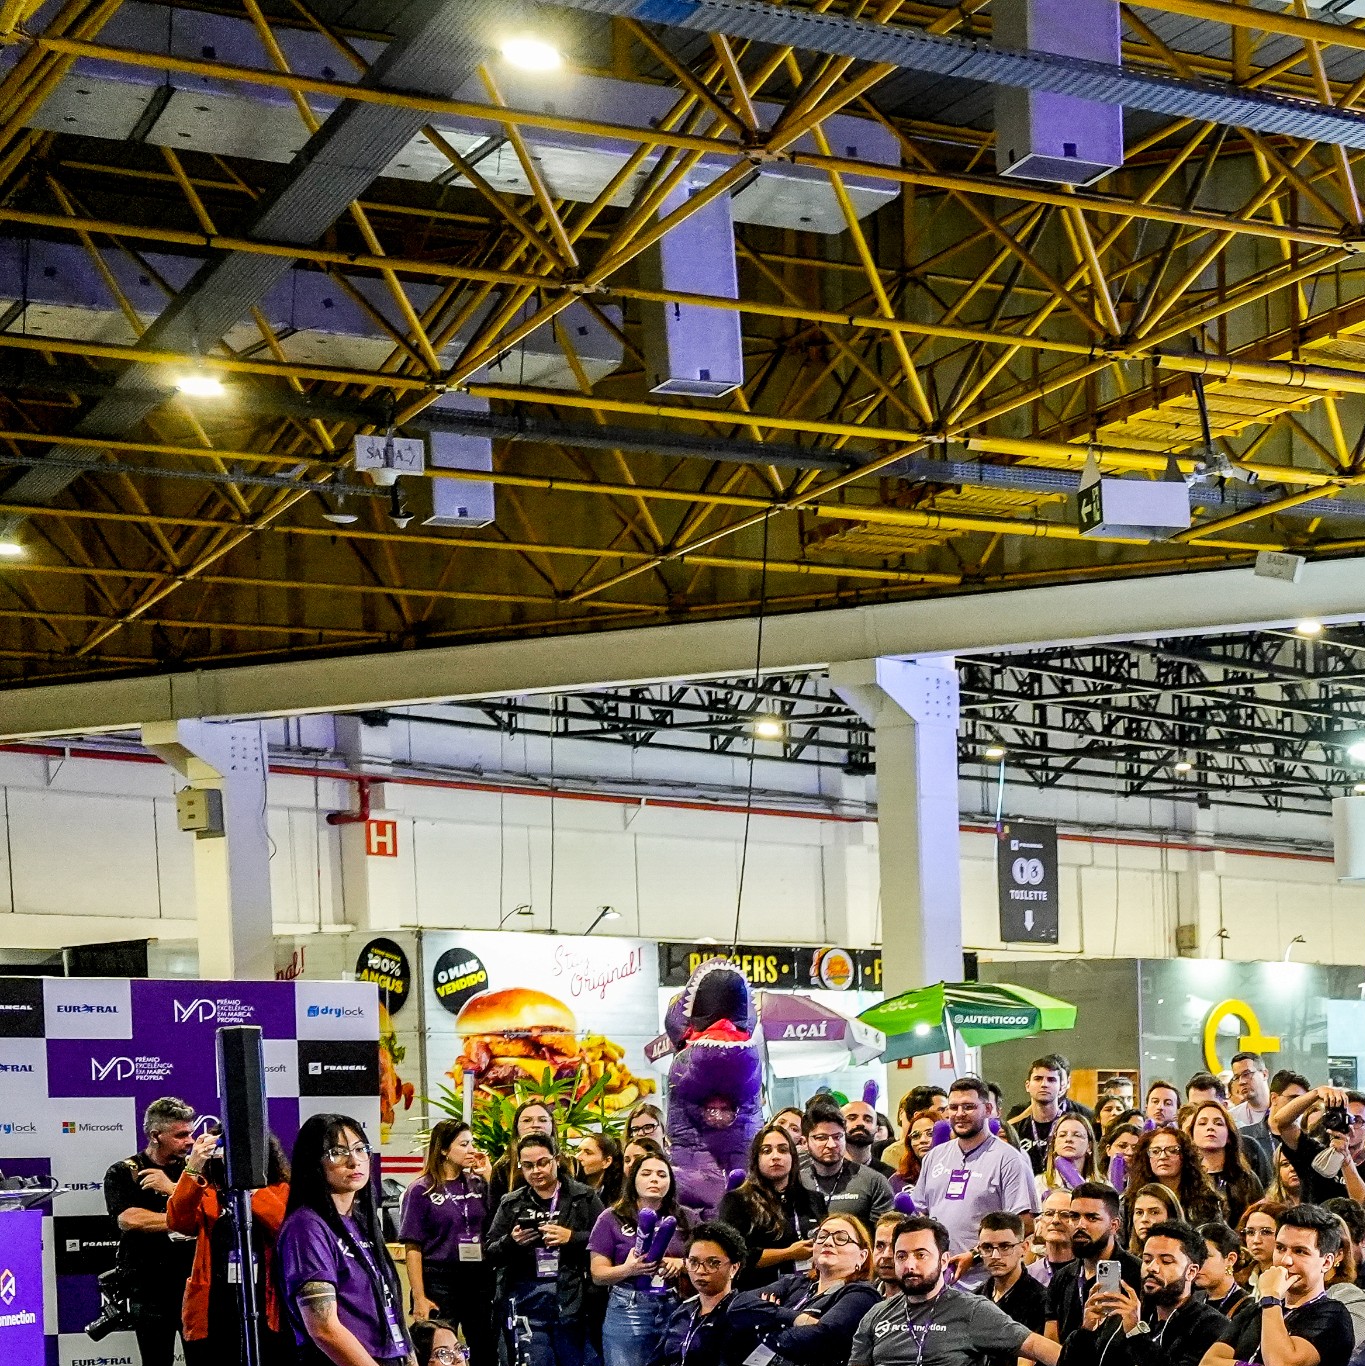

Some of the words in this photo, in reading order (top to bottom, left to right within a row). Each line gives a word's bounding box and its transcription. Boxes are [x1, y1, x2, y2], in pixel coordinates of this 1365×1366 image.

[366, 446, 403, 461] SAA
[370, 823, 394, 855] H
[1009, 890, 1048, 901] TOILETTE
[438, 972, 449, 984] O
[450, 959, 480, 980] MAIS
[359, 969, 404, 994] ANGUS
[436, 971, 487, 998] VENDIDO
[57, 1004, 119, 1014] EUROFRAL
[321, 1004, 364, 1018] drylock
[783, 1021, 827, 1040] AÇAÍ
[265, 1063, 287, 1073] osoft
[79, 1122, 123, 1132] Microsoft
[65, 1182, 103, 1191] EUROF
[72, 1357, 133, 1366] EUROFRAL
